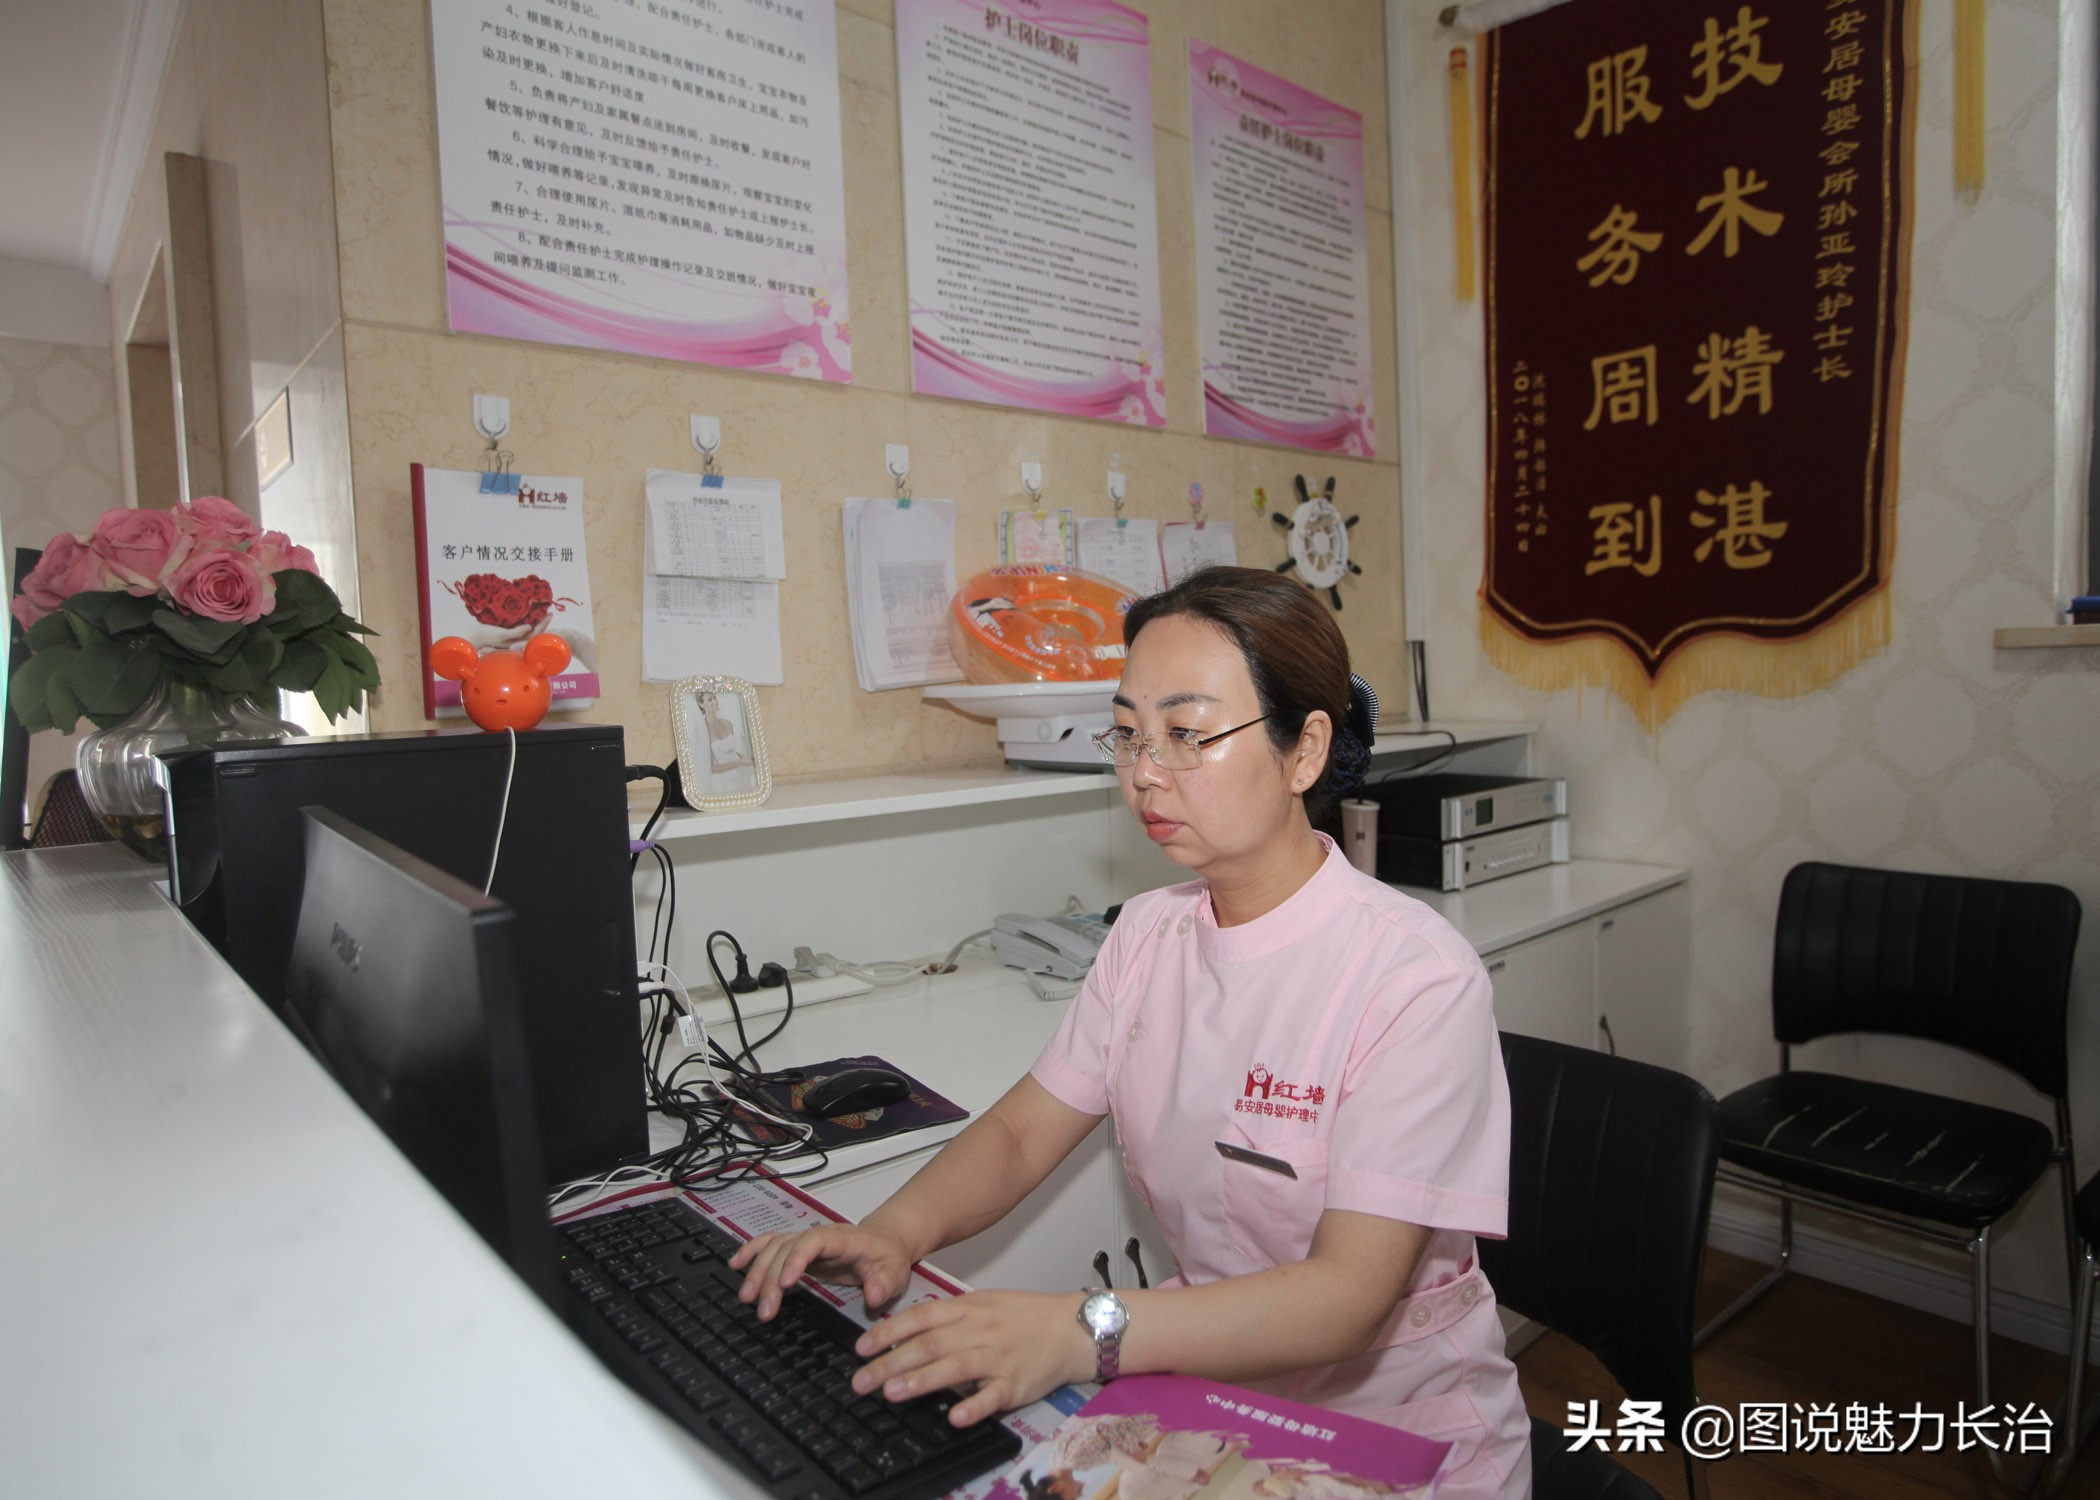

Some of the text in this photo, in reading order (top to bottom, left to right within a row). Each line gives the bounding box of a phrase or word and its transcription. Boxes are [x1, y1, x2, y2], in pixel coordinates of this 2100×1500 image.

[1684, 5, 1788, 569] 技术精湛
[1574, 45, 1663, 577] 服务周到
[537, 491, 568, 504] 红墙
[442, 544, 574, 562] 客户情况交接手册
[1272, 1080, 1326, 1105] 红墙
